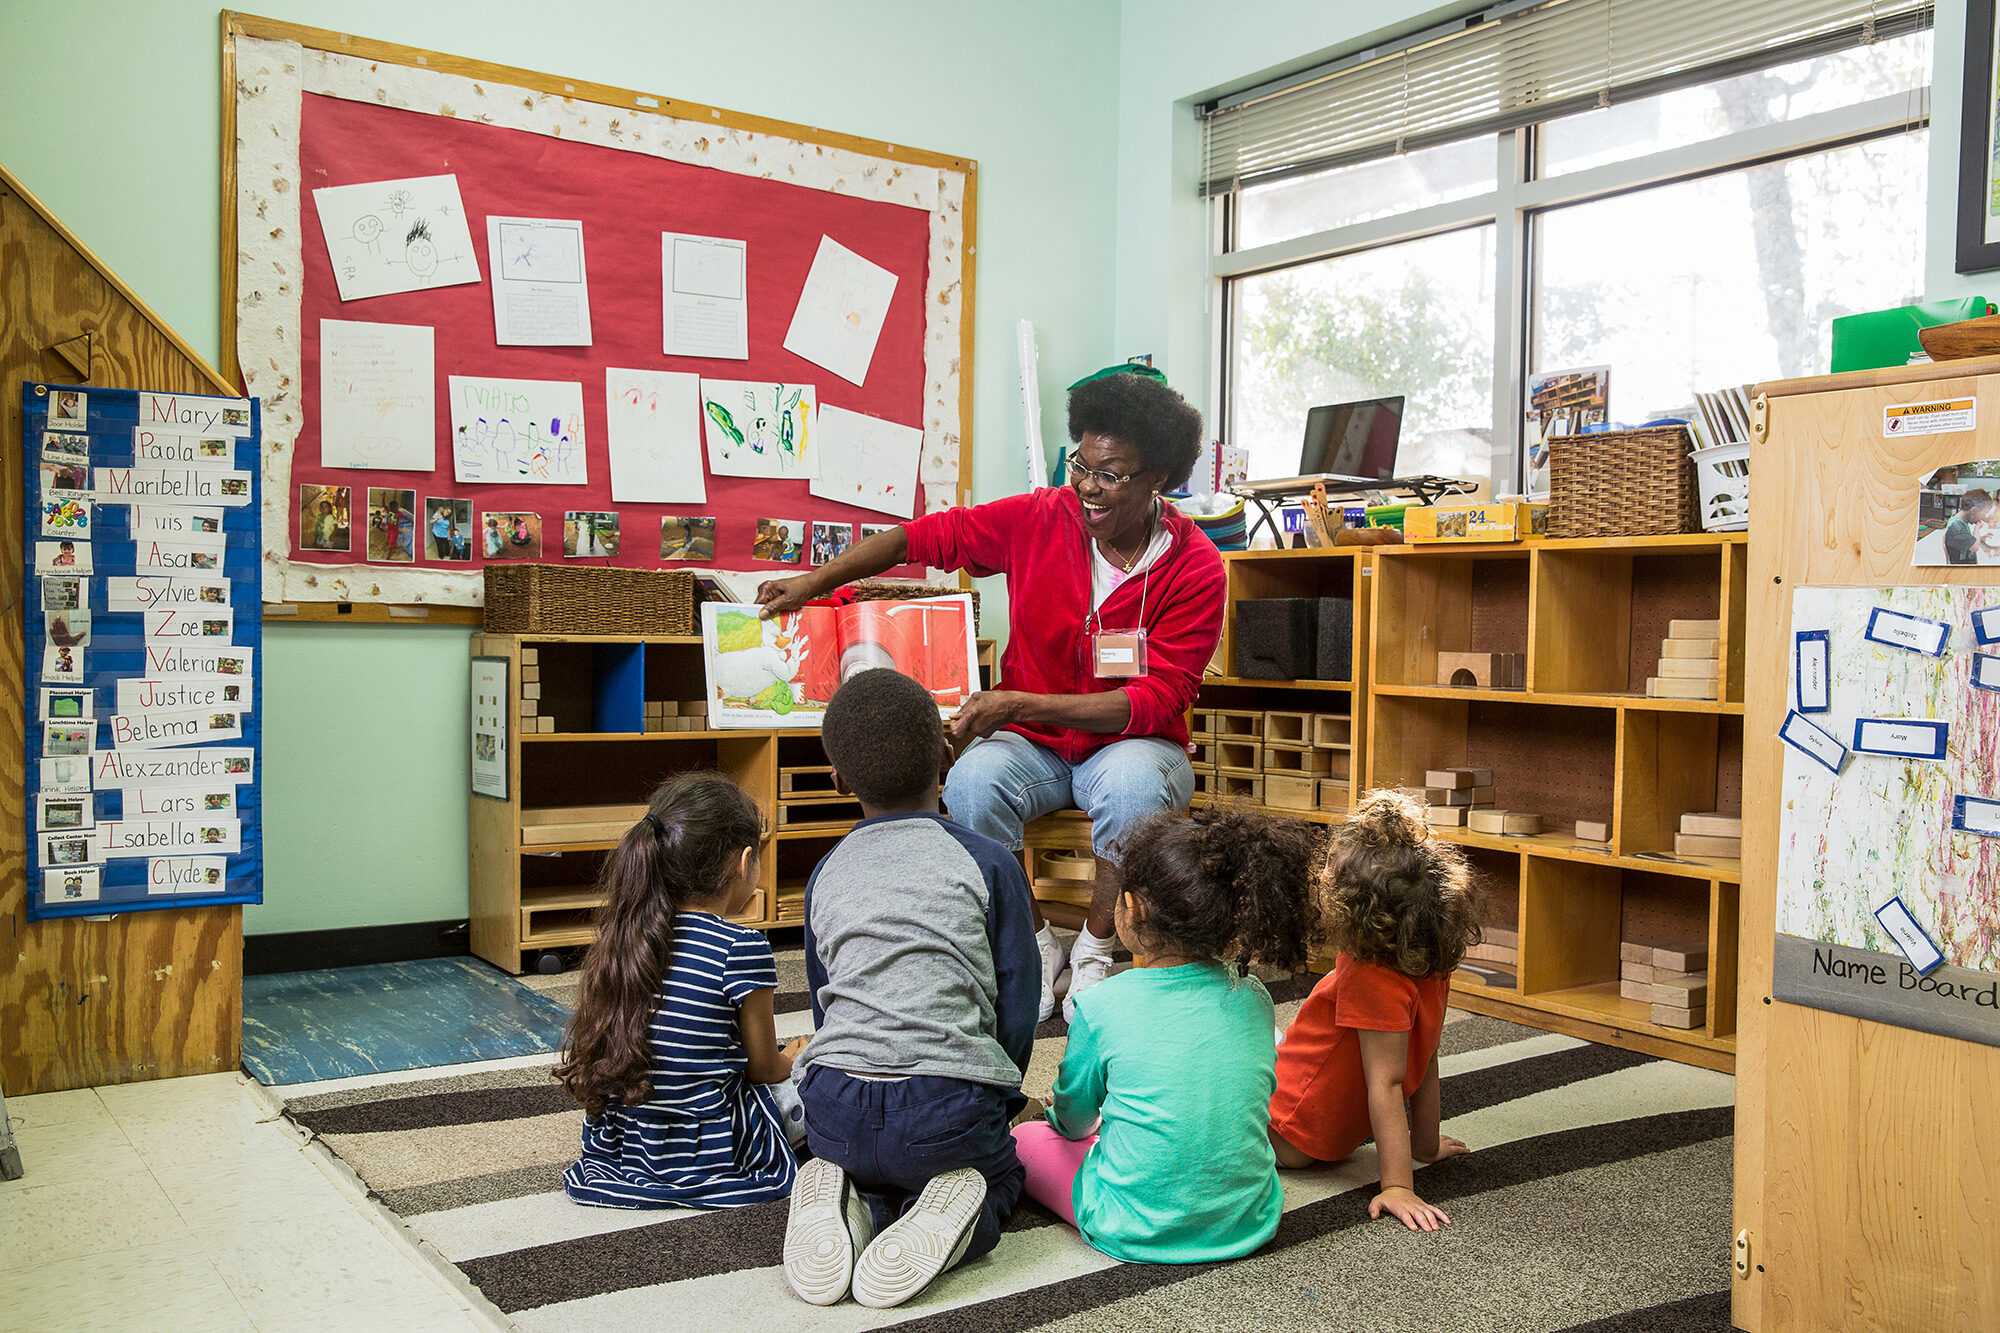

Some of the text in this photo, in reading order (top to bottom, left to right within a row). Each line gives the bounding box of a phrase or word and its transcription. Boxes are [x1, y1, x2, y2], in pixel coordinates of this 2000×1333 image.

[152, 395, 219, 433] Mary
[1911, 403, 1952, 414] WARNING
[140, 431, 194, 462] Paola
[109, 468, 211, 497] Maribella
[1468, 510, 1486, 524] 24
[1468, 523, 1488, 531] Floor
[148, 541, 188, 568] Asa
[136, 577, 198, 609] Sylvie
[154, 610, 199, 637] Zoe
[147, 646, 216, 673] Valeria
[139, 680, 215, 707] Justice
[115, 714, 198, 743] Belema
[1890, 732, 1908, 741] Mary
[99, 750, 222, 779] Alexzander
[139, 789, 195, 814] Lars
[100, 822, 195, 849] Isabella
[152, 859, 201, 892] Clyde
[1812, 947, 2000, 1009] Name Board
